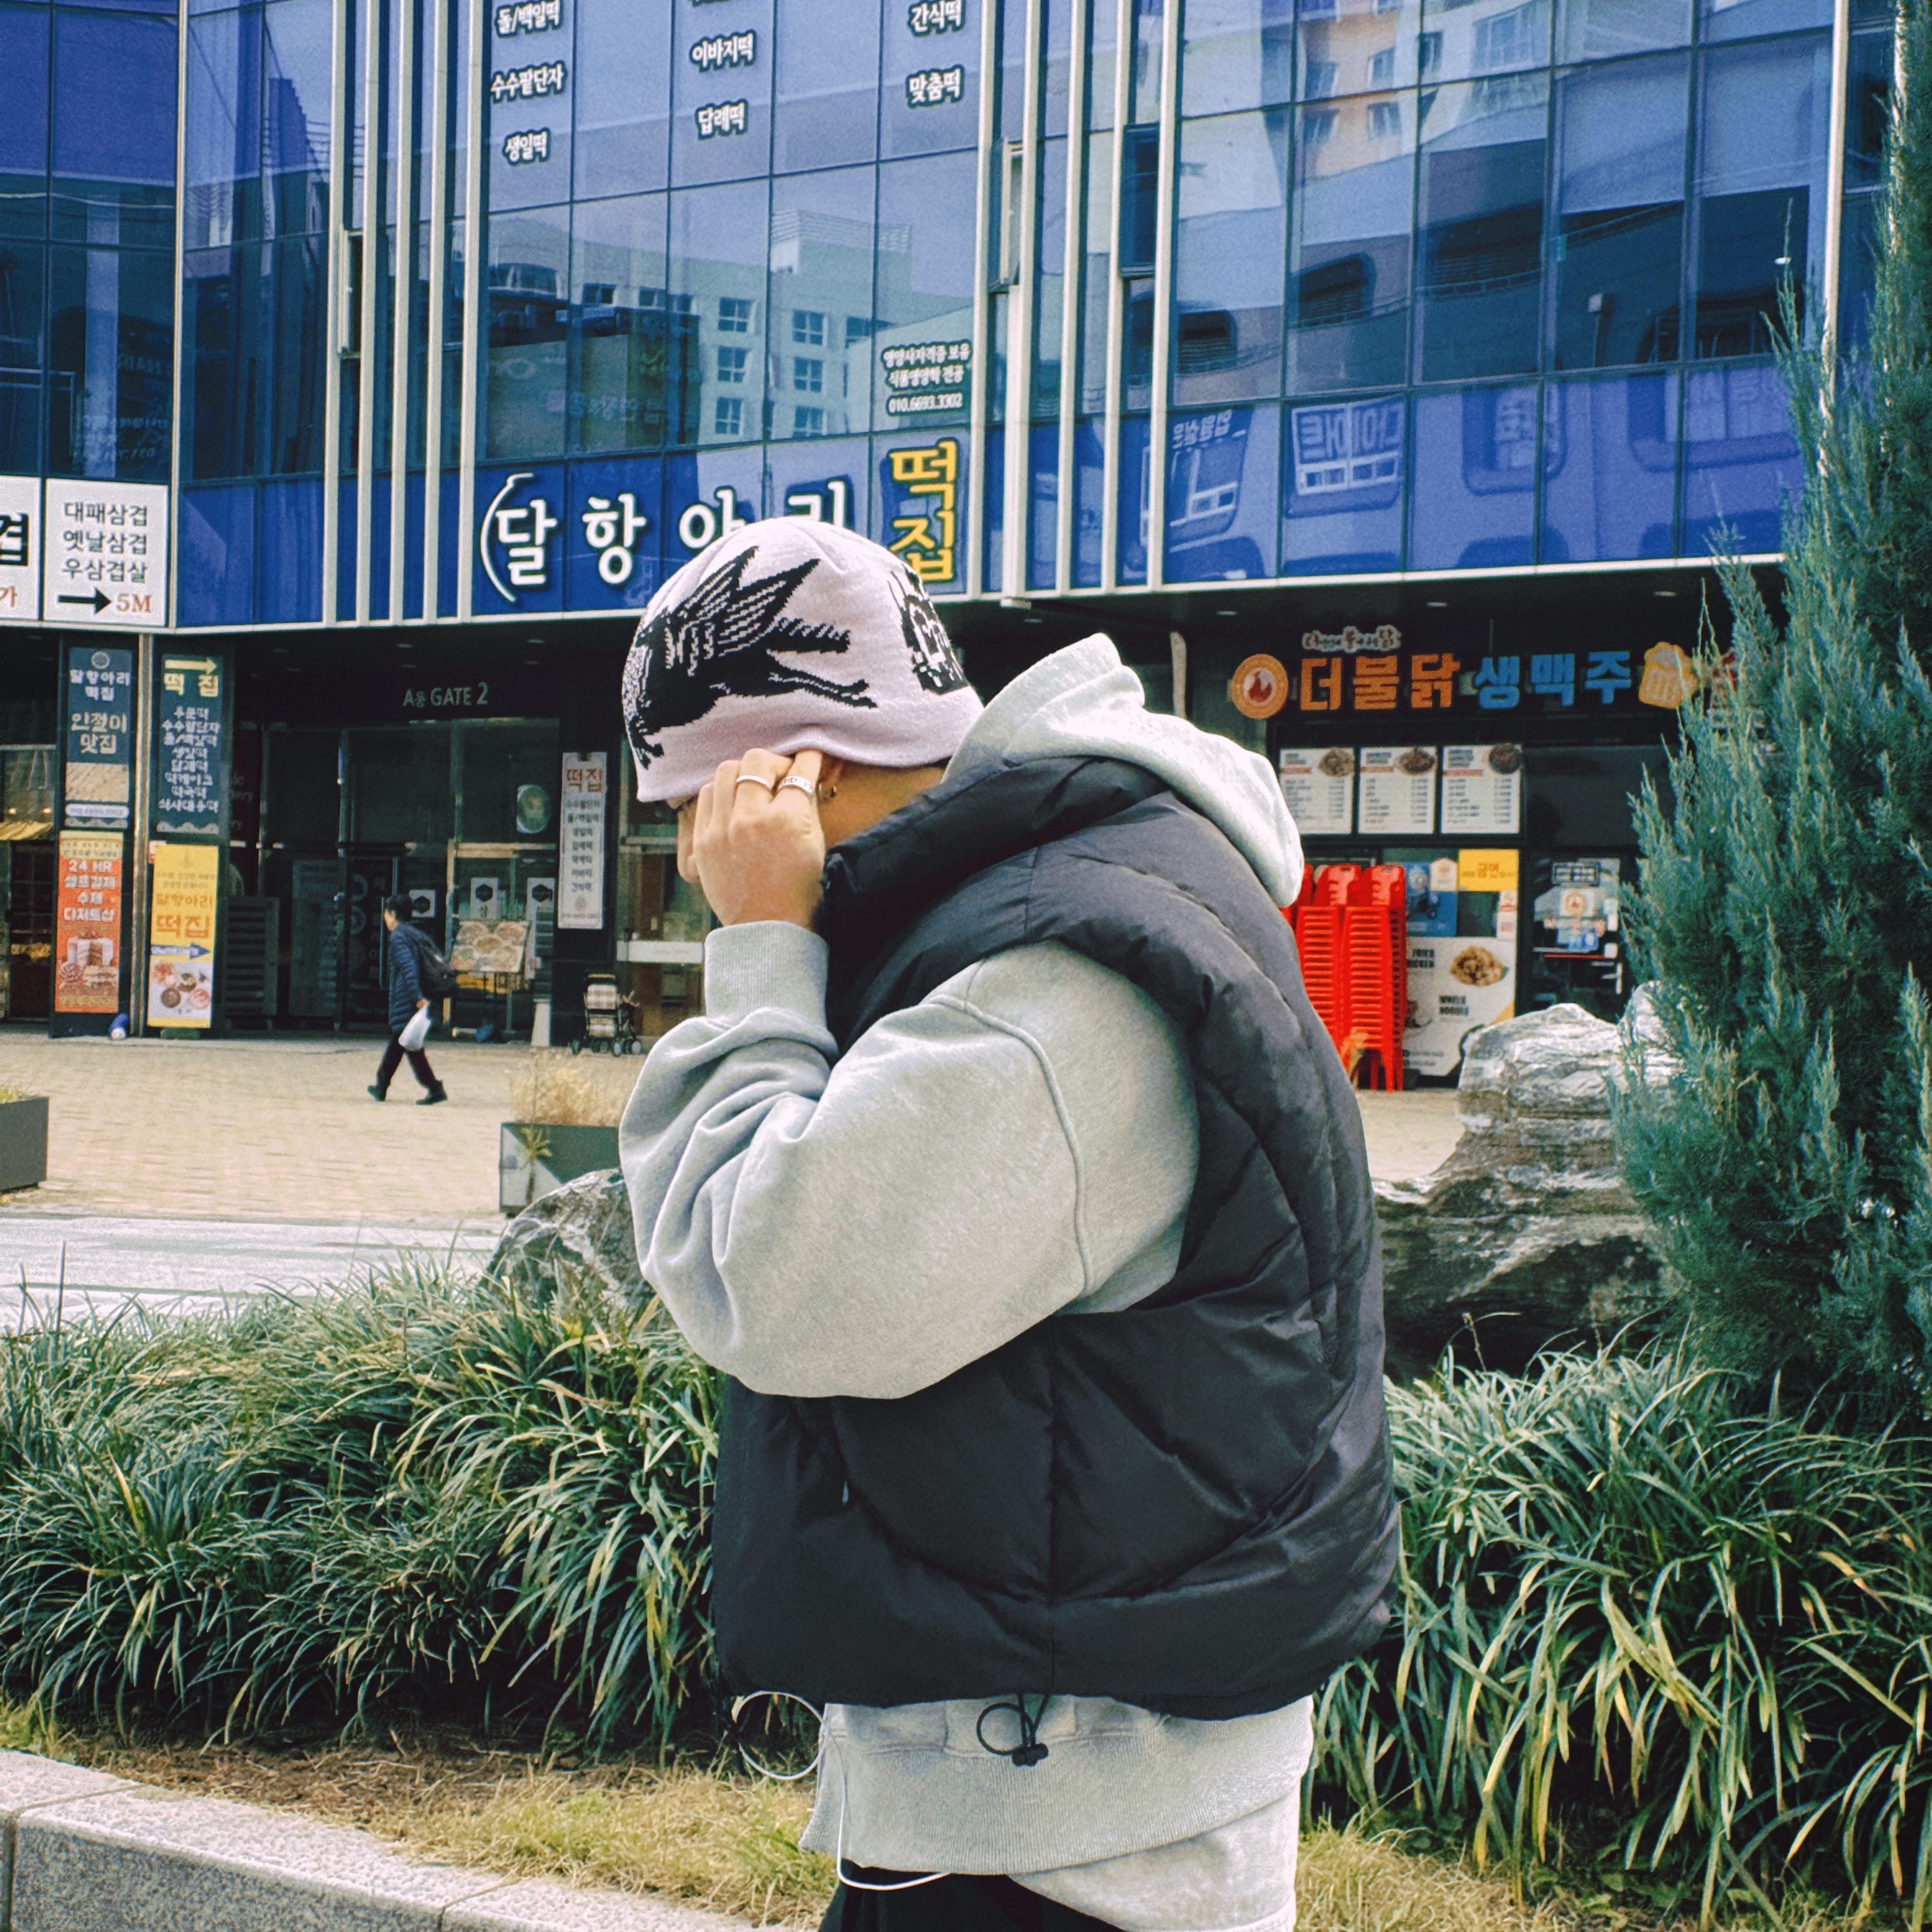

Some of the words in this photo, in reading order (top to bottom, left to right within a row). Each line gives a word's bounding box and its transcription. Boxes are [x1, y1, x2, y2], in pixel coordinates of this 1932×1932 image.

[496, 0, 561, 35] 돌/백일떡
[911, 0, 962, 33] 간식떡
[691, 33, 754, 68] 이바지떡
[490, 63, 564, 100] 수수팥단자
[909, 68, 961, 103] 맞춤떡
[698, 102, 745, 136] 답례떡
[505, 131, 548, 163] 생일떡
[948, 342, 971, 361] 보유
[63, 502, 148, 526] 대패삼겹
[889, 440, 956, 582] 떡집
[63, 530, 147, 555] 옛날삼겹
[62, 558, 148, 583] 우삼겹살
[116, 593, 152, 614] 5M
[69, 669, 131, 686] 달항아리
[431, 687, 471, 707] GATE
[477, 681, 489, 705] 2
[70, 711, 127, 733] 인절미
[79, 733, 117, 755] 맛집
[566, 769, 604, 794] 떡집
[68, 860, 88, 873] 24
[93, 861, 112, 873] HR
[156, 914, 210, 939] 떡집
